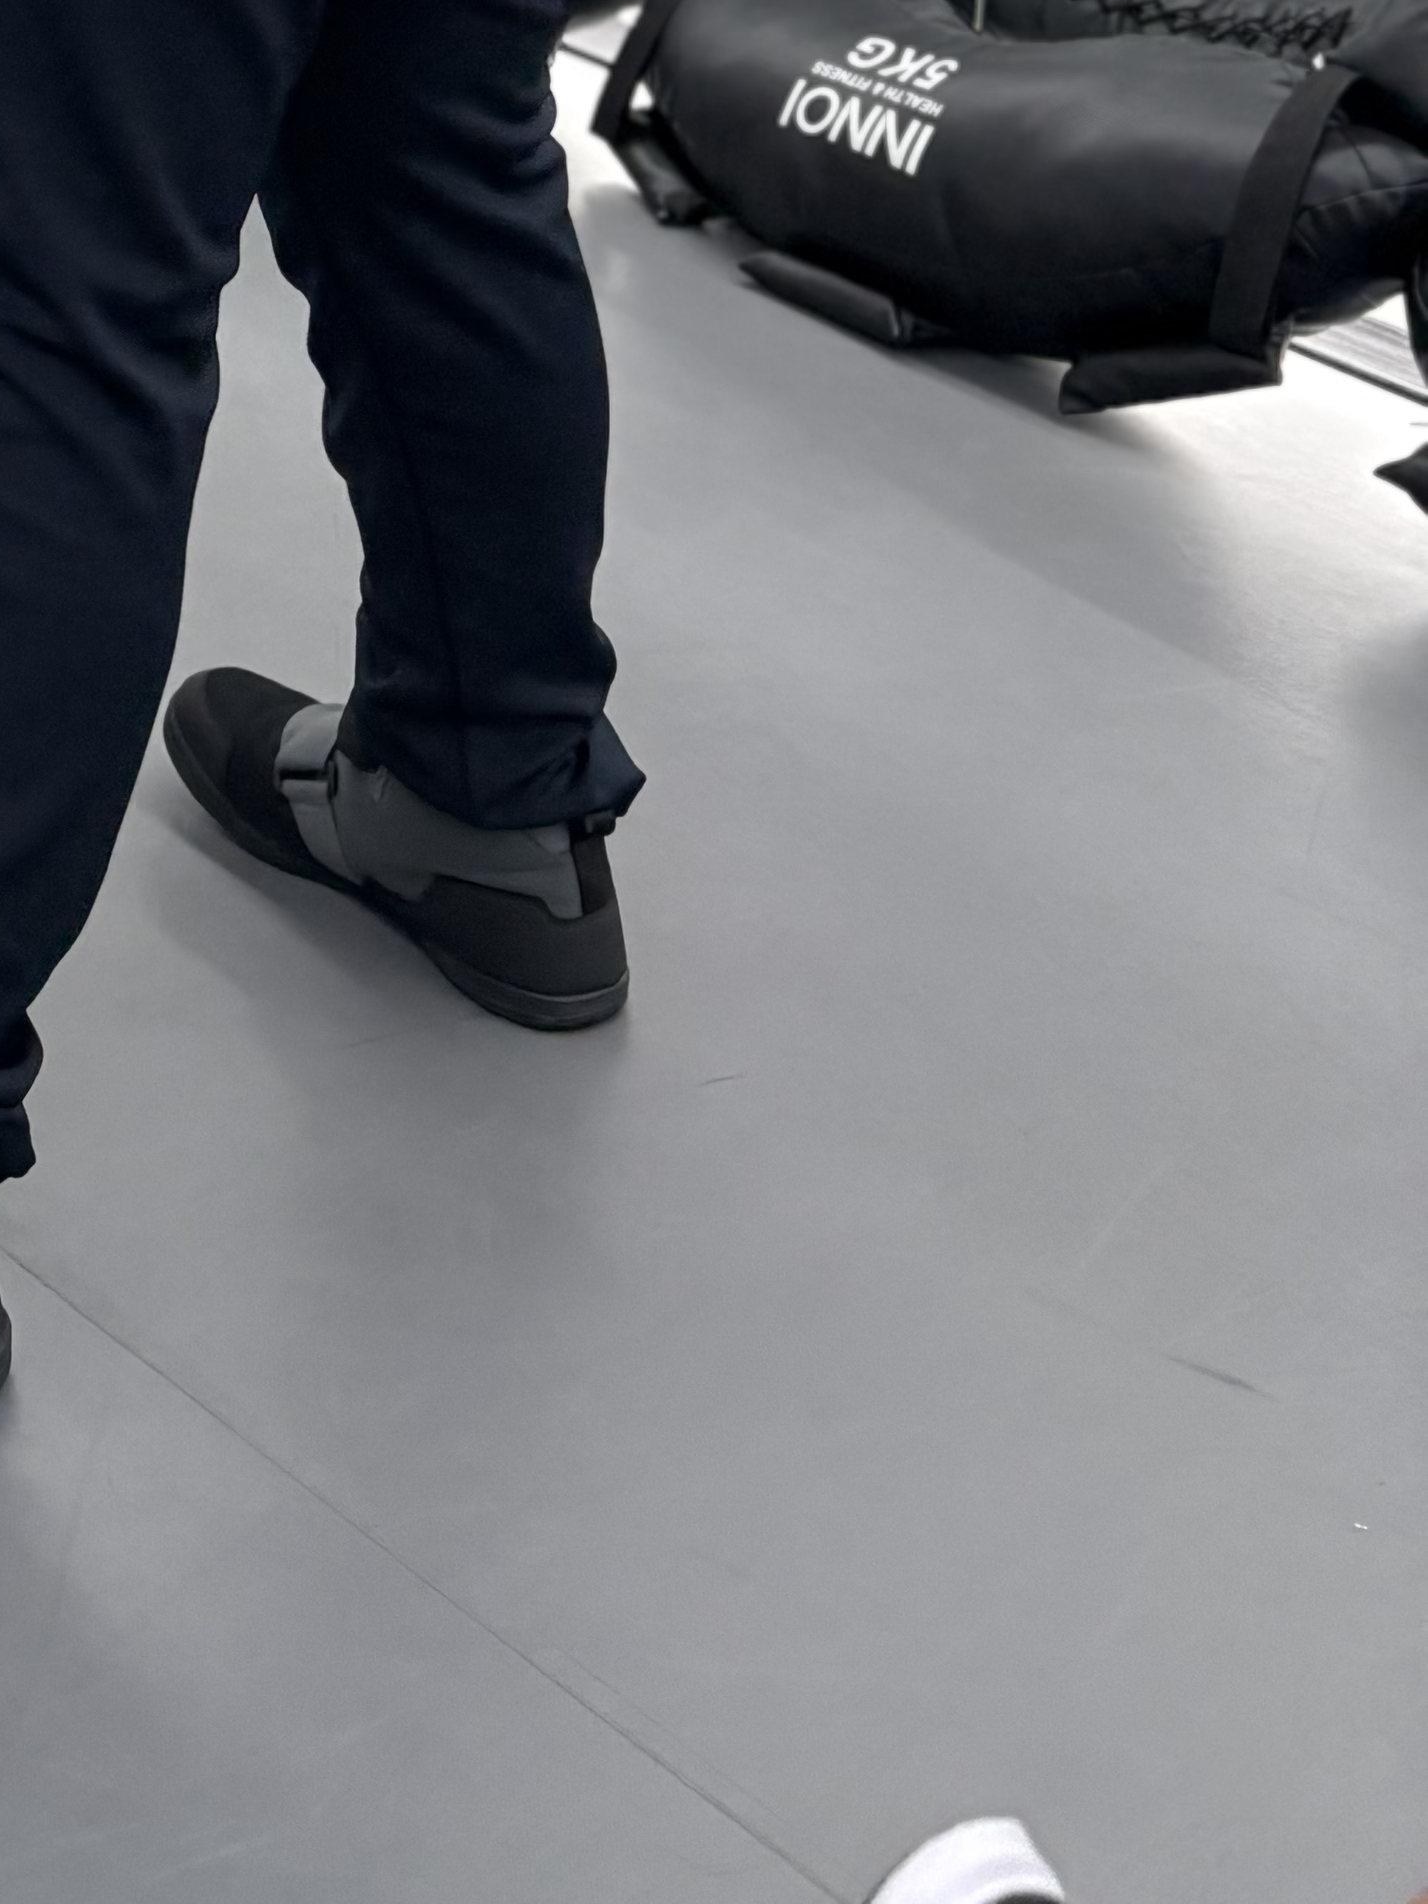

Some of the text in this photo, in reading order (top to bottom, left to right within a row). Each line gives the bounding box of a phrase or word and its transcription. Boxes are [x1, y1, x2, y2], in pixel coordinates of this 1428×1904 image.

[811, 61, 873, 91] FITNESS
[846, 37, 959, 90] 5KG
[885, 86, 943, 117] HEALTH
[778, 78, 935, 176] INNOI
